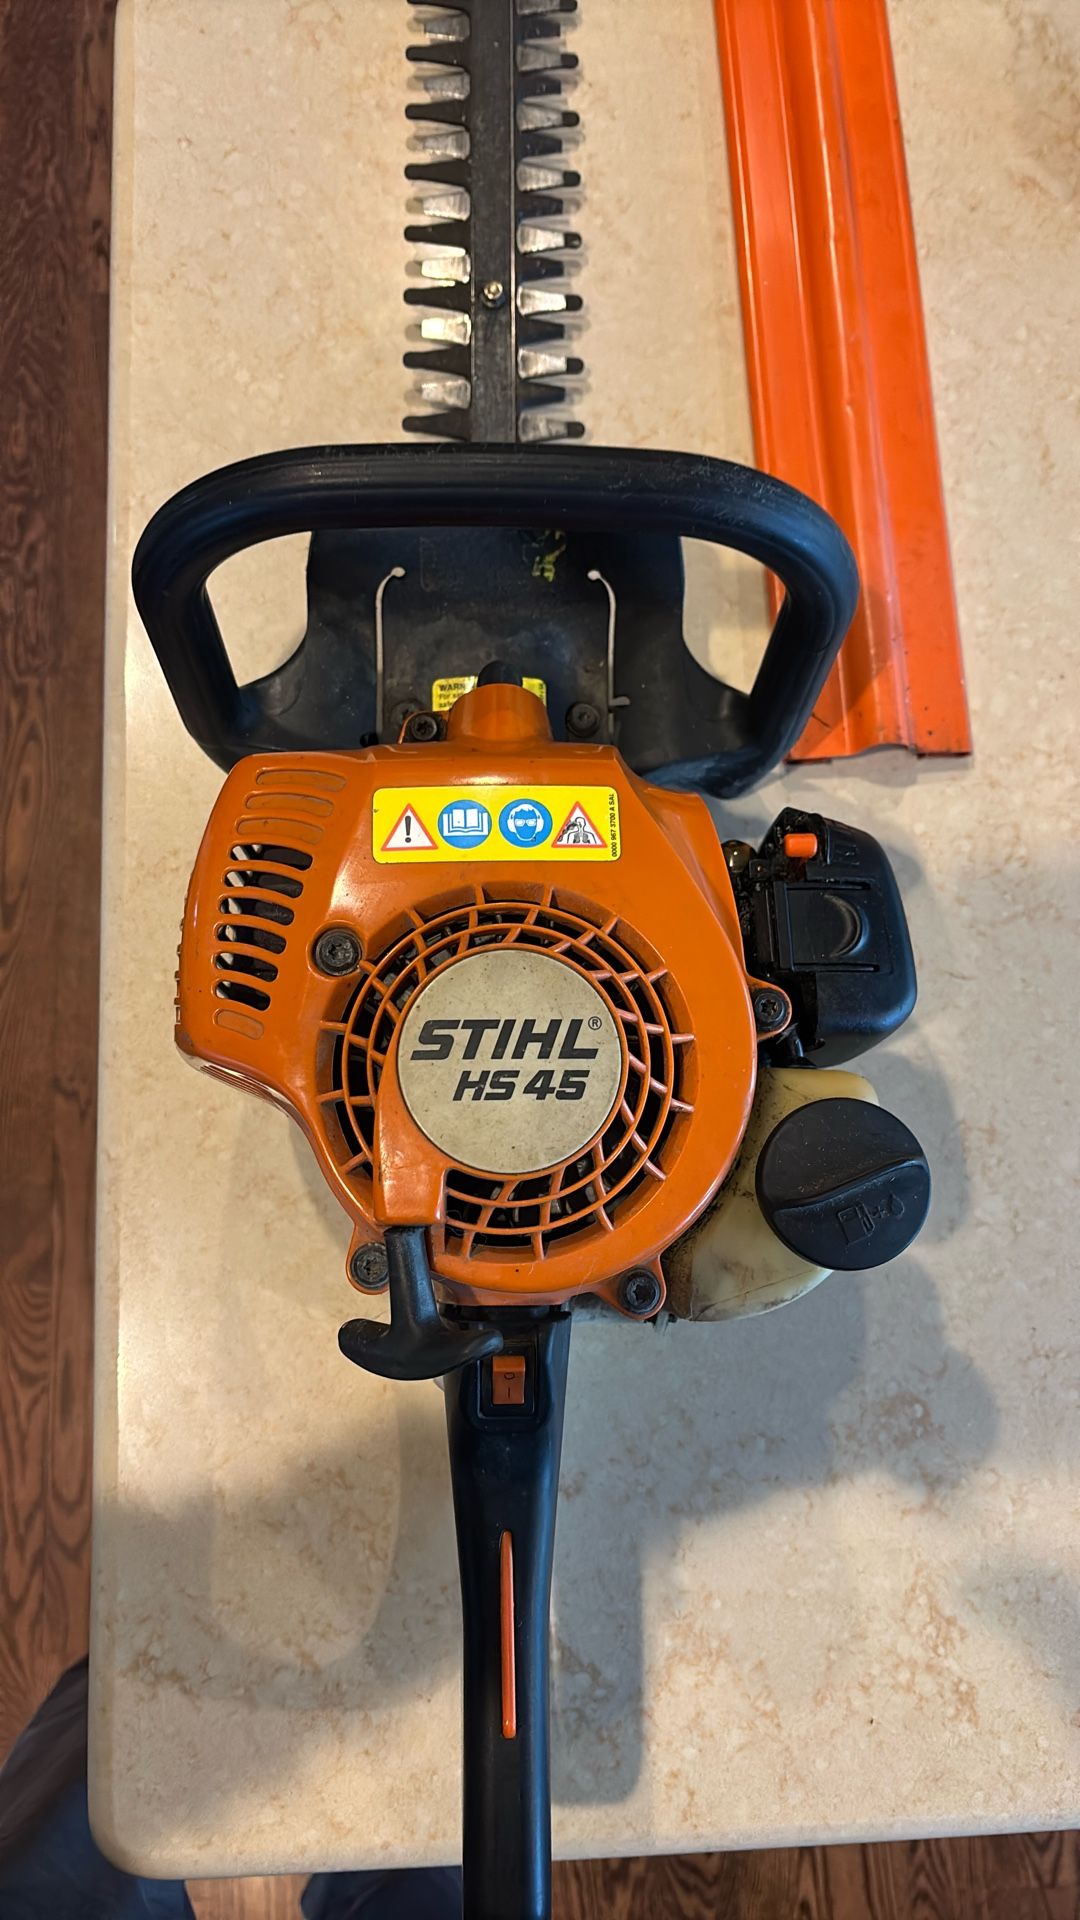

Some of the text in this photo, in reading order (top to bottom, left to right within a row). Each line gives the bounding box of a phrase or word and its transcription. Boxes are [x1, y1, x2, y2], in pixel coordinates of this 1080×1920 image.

[439, 683, 466, 692] WARN
[452, 1069, 590, 1101] HS 45
